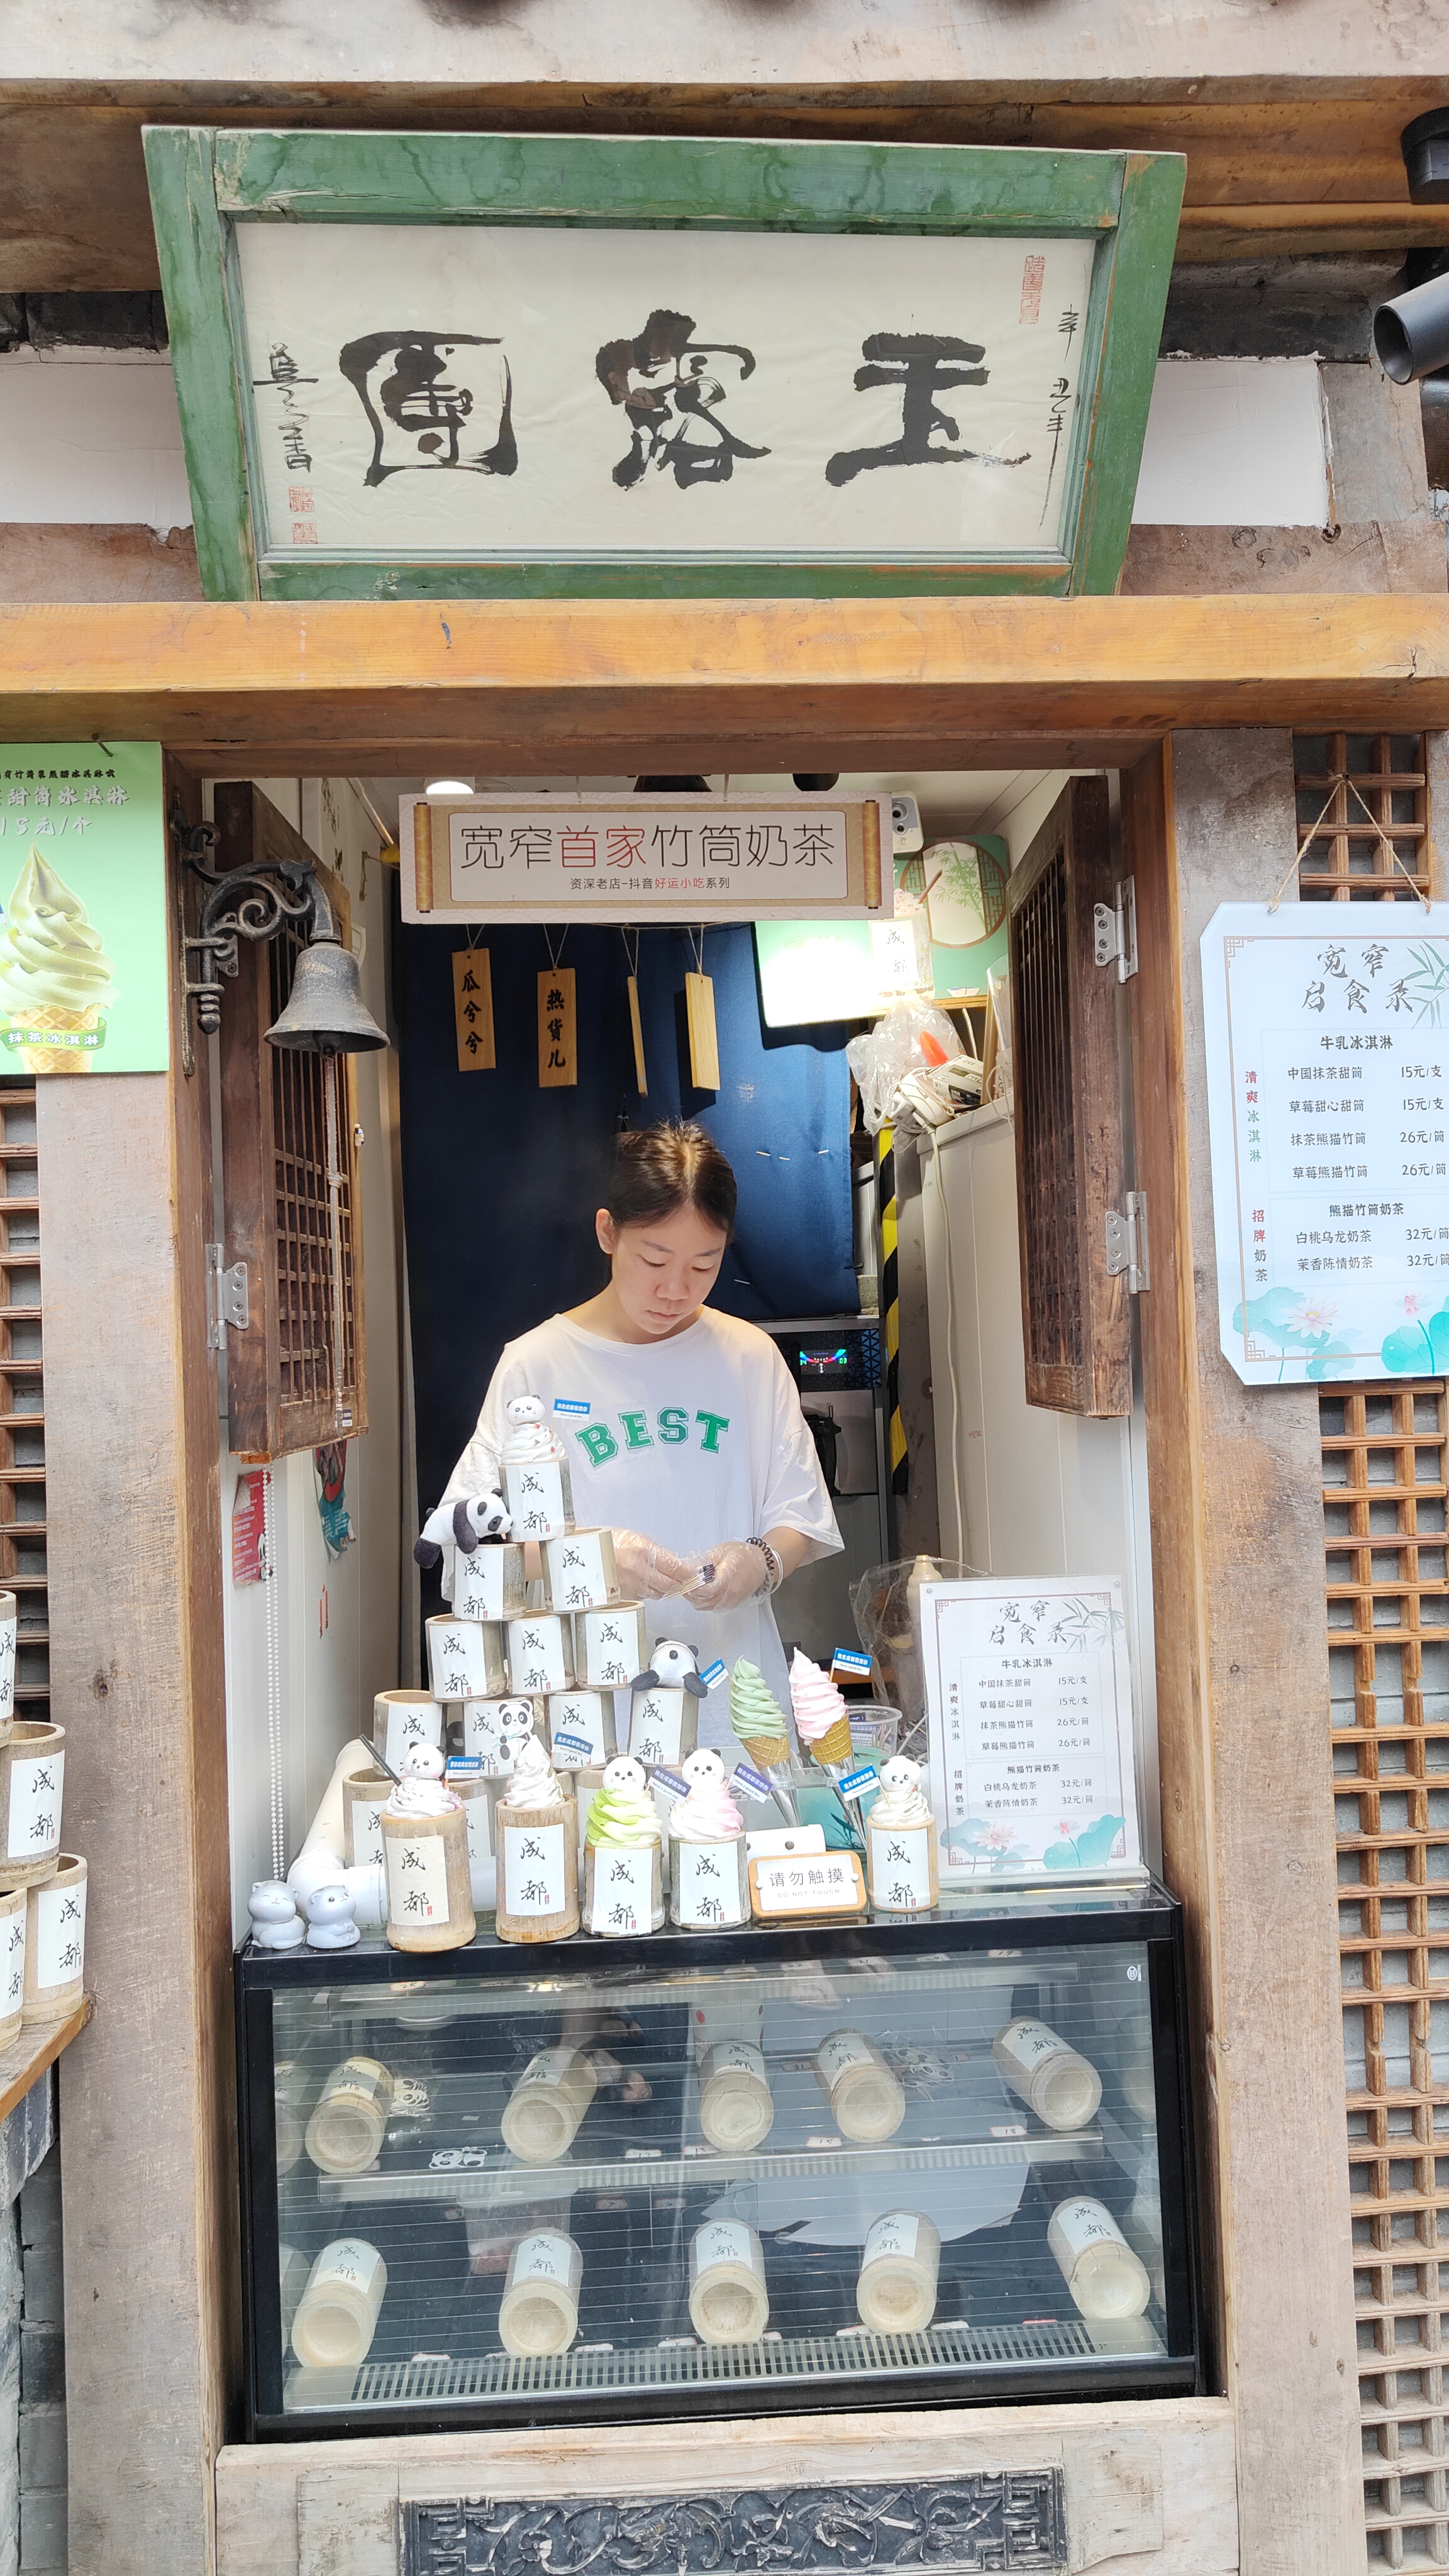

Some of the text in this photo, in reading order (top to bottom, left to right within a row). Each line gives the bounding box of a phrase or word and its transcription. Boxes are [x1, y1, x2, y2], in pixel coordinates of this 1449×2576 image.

[0, 785, 130, 807] 甜筒冰淇淋
[461, 823, 835, 869] 宽窄首家竹筒奶茶
[1317, 943, 1389, 978] 宽窄
[462, 969, 484, 1055] 瓜兮兮
[547, 989, 566, 1068] 热货儿
[8, 1031, 99, 1046] 抹茶冰淇淋
[1320, 1035, 1394, 1050] 牛乳冰淇淋
[1288, 1065, 1442, 1080] 中国抹茶甜筒 15元/支
[1245, 1070, 1262, 1162] 清爽冰淇淋
[1289, 1097, 1445, 1113] 草莓甜心甜筒 15元/支
[1291, 1130, 1445, 1146] 抹茶熊猫竹筒 26元/筒
[1292, 1163, 1446, 1179] 草莓熊猫竹筒 26元/筒
[1329, 1202, 1404, 1217] 熊猫竹筒奶茶
[1252, 1209, 1268, 1282] 招牌奶茶
[1296, 1227, 1449, 1245] 白桃乌龙奶茶 32元/筒
[1297, 1256, 1373, 1271] 茉香陈情奶茶
[575, 1407, 730, 1467] BEST
[521, 1472, 548, 1533] 成都
[463, 1557, 486, 1619] 成都
[562, 1546, 590, 1608] 成都
[443, 1633, 469, 1696] 成都
[522, 1629, 548, 1691] 成都
[599, 1621, 625, 1684] 成都
[1001, 1658, 1053, 1669] 牛乳冰淇淋
[979, 1675, 1087, 1689] 中国抹茶甜筒 15元/支
[979, 1696, 1089, 1709] 草莓甜心甜筒 15元/支
[639, 1699, 664, 1763] 成都
[949, 1683, 961, 1741] 清爽冰淇淋
[980, 1717, 1089, 1730] 抹茶熊猫竹筒 26元/筒
[982, 1738, 1091, 1751] 草莓熊猫竹筒 26元/筒
[984, 1779, 1092, 1792] 白桃乌龙奶茶 32元/筒
[1007, 1763, 1060, 1774] 熊猫竹筒奶茶
[30, 1765, 55, 1841] 成都
[954, 1770, 965, 1816] 招牌奶茶
[1062, 1795, 1093, 1804] 32元/筒
[401, 1846, 429, 1916] 成都
[521, 1836, 547, 1905] 成都
[696, 1854, 722, 1922] 成都
[769, 1867, 844, 1887] 请勿触摸
[887, 1840, 913, 1907] 成都
[608, 1860, 634, 1929] 成都
[58, 1894, 81, 1968] 成都
